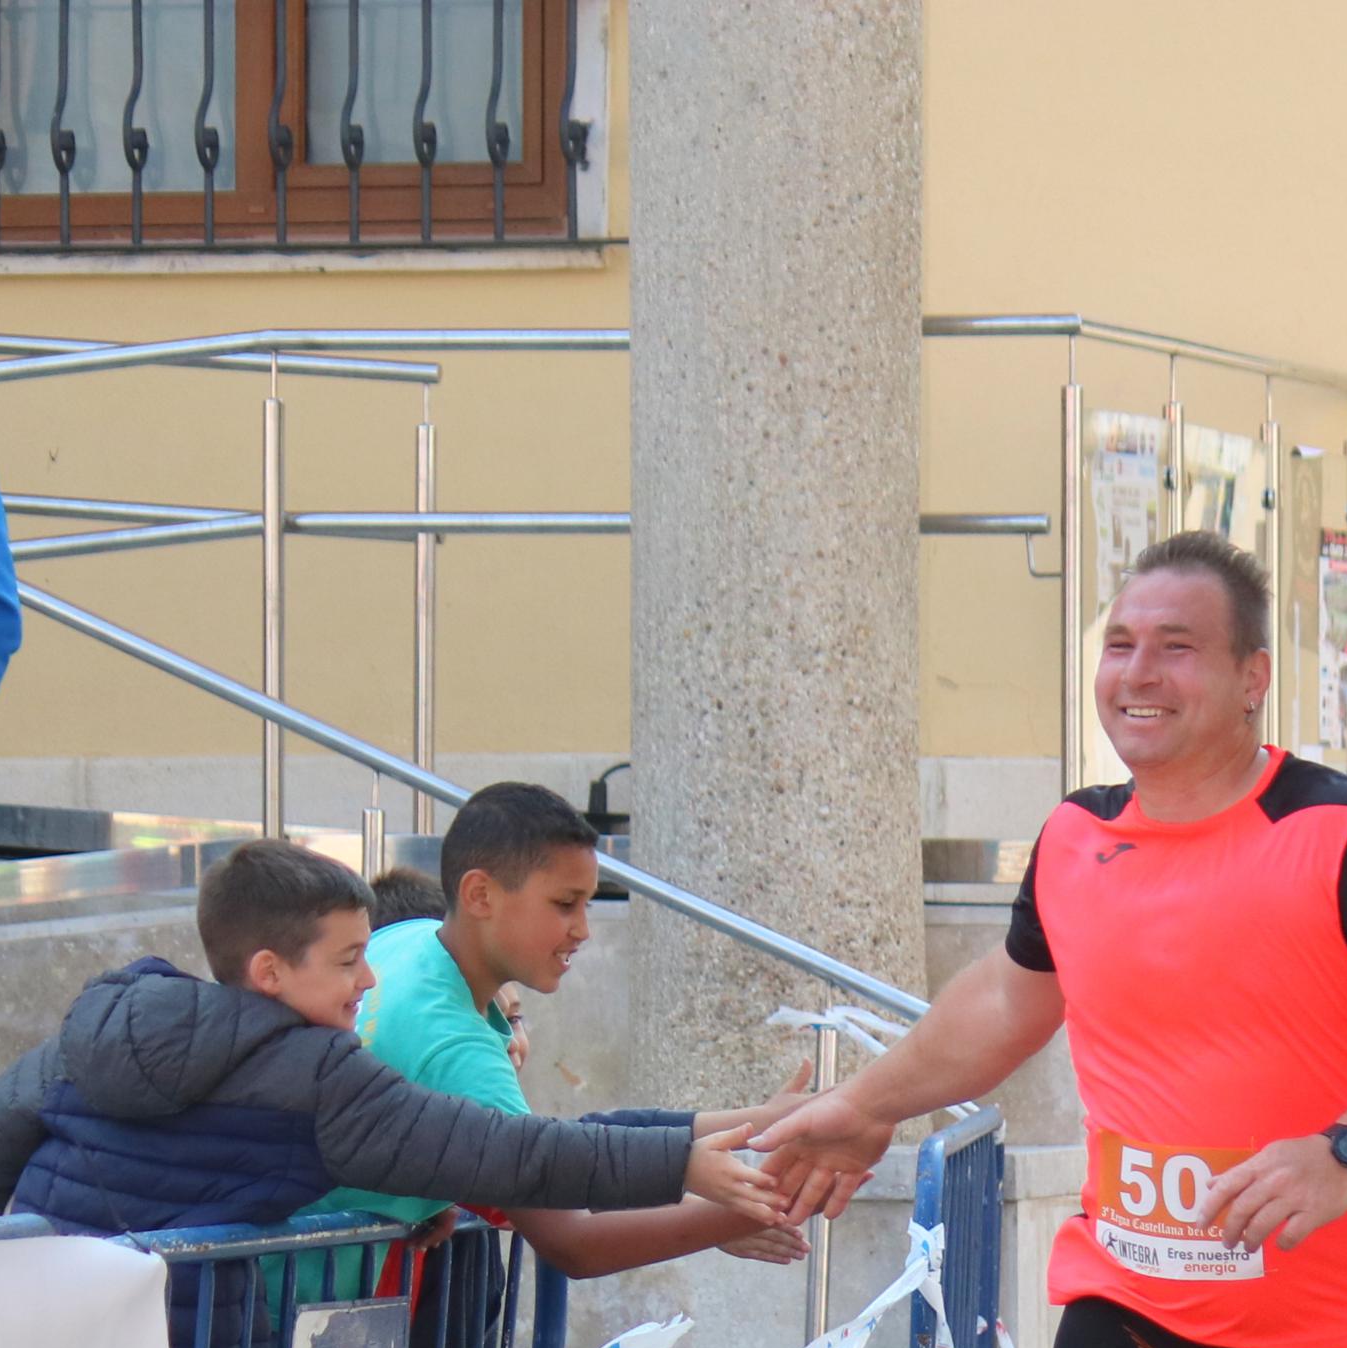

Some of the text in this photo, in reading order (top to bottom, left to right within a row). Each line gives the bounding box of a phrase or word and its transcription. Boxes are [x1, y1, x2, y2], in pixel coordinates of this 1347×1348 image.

[1132, 1218, 1184, 1236] Castellana
[1118, 1240, 1159, 1267] INTEGRA
[1167, 1247, 1250, 1261] Eres nuestra
[1184, 1261, 1236, 1275] energía
